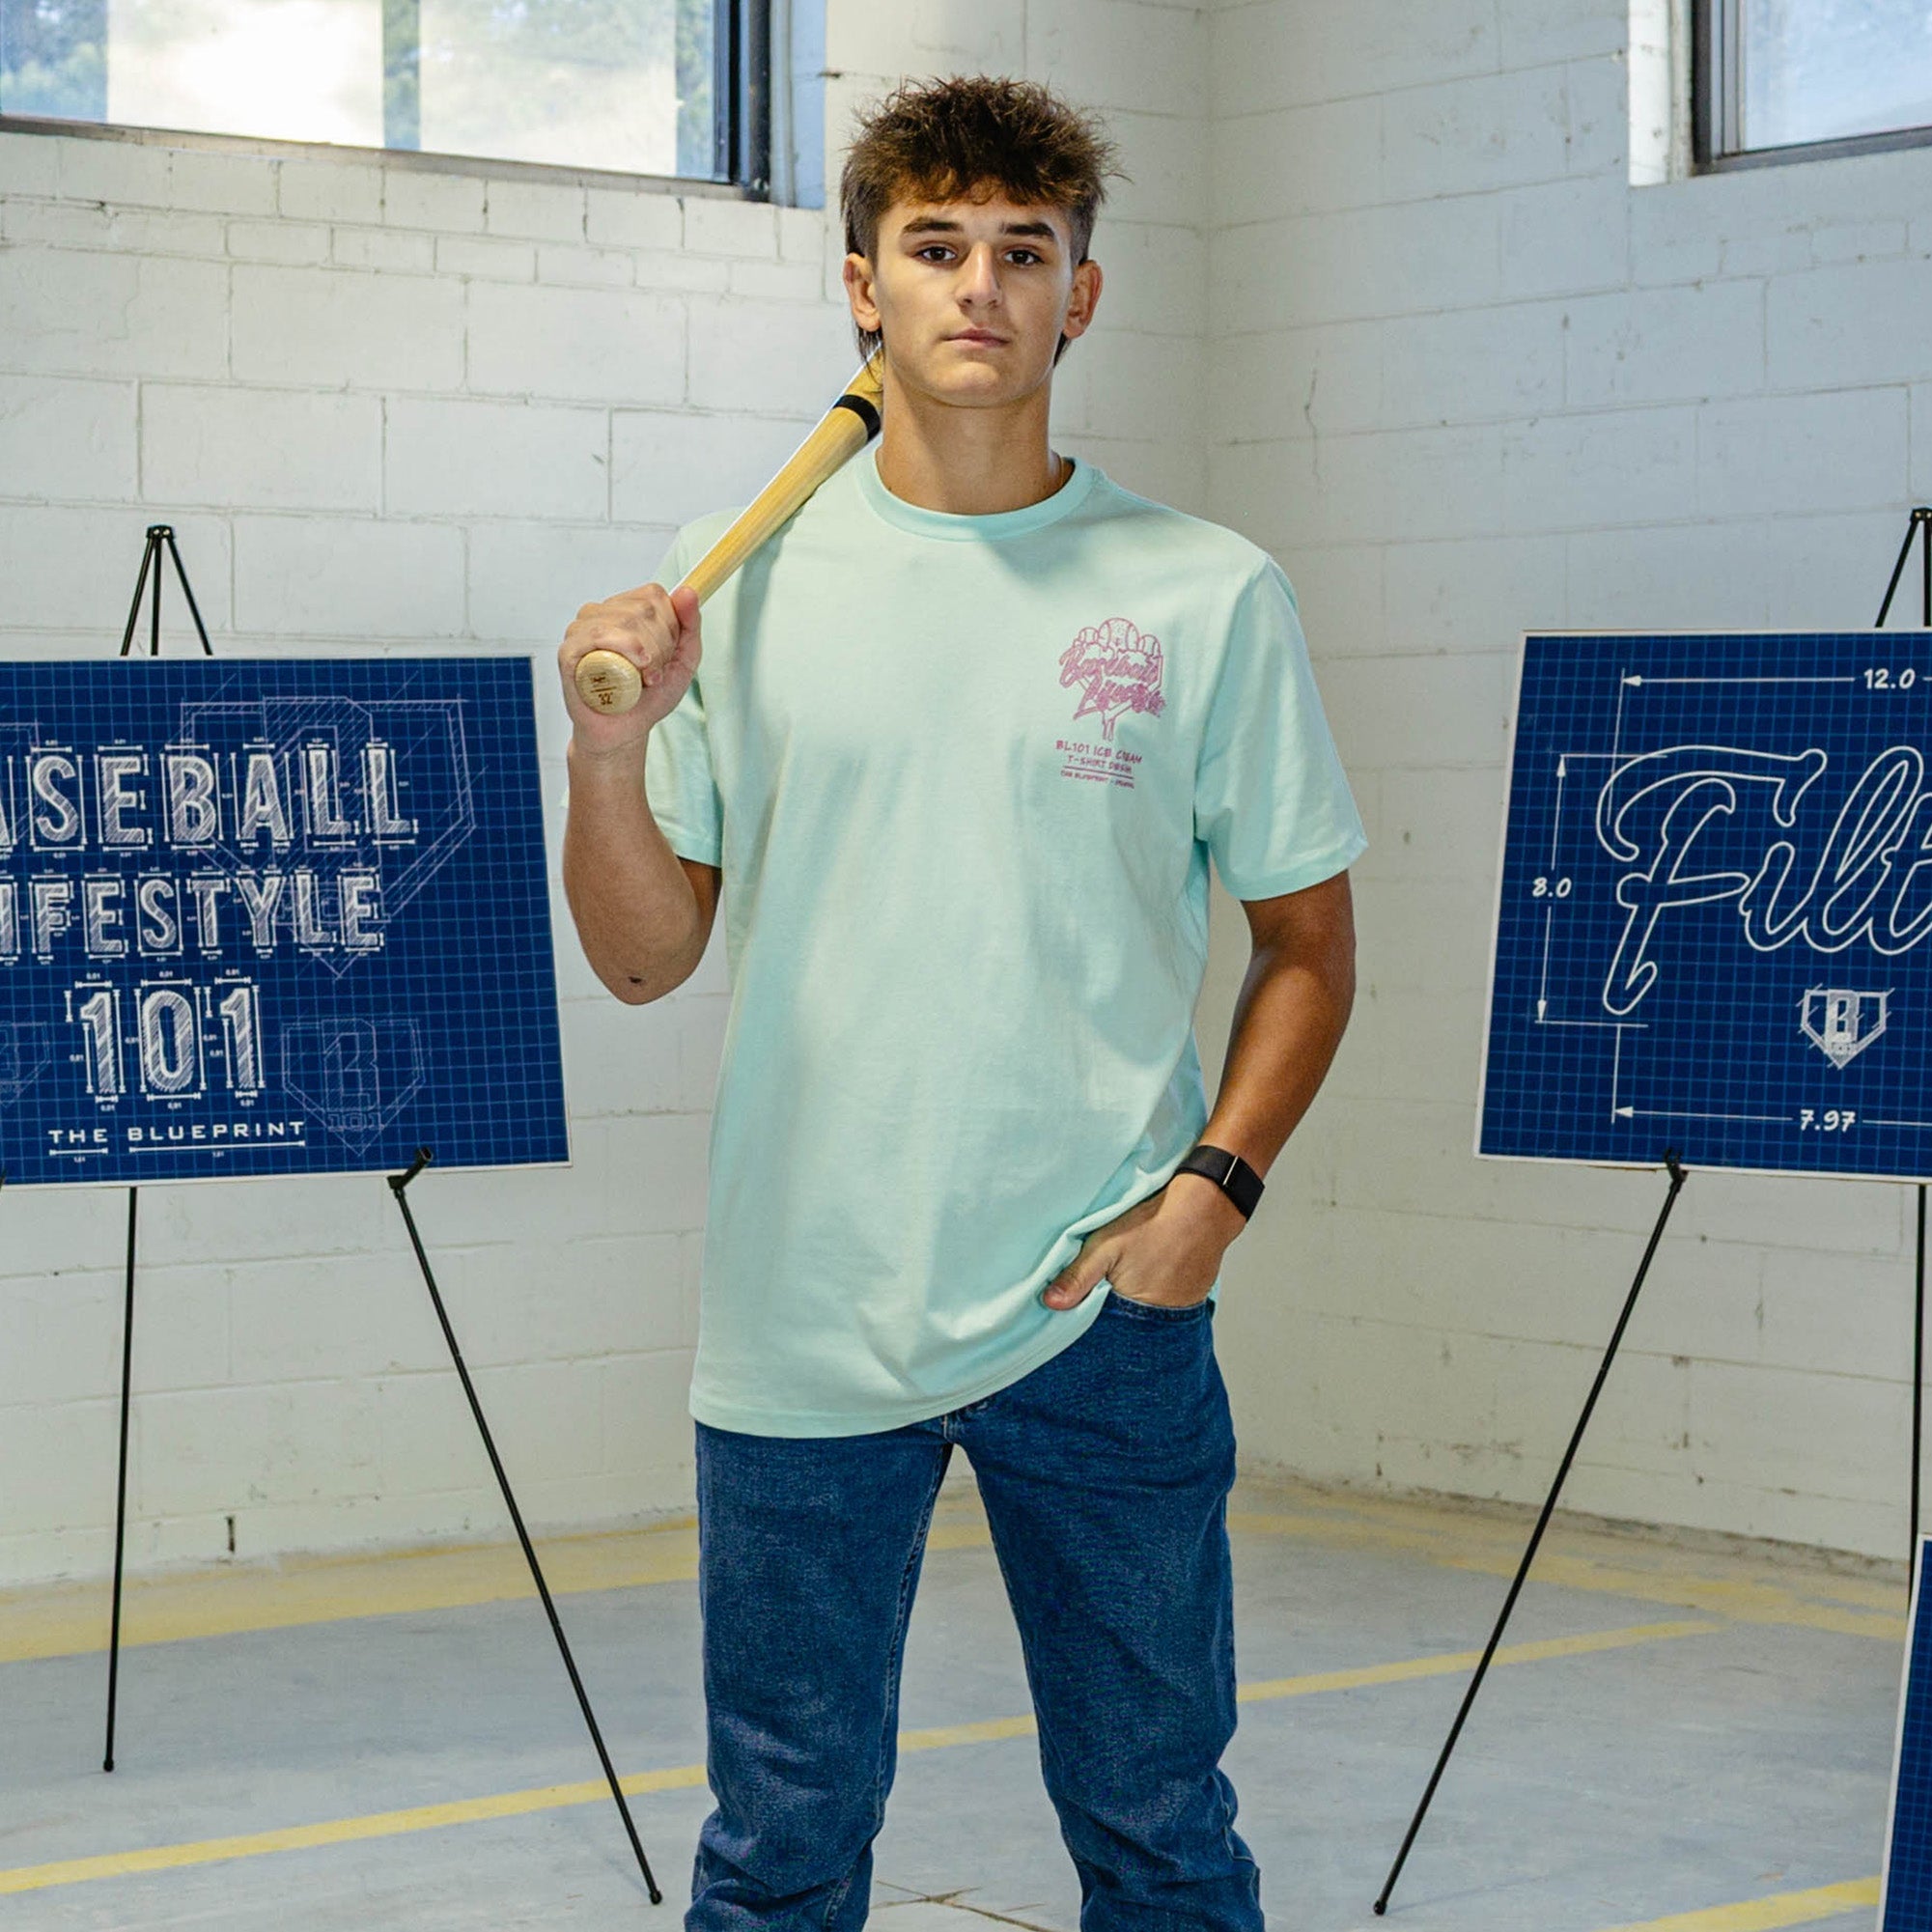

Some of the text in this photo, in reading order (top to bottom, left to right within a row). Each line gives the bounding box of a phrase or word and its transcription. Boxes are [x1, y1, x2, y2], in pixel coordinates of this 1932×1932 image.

[1863, 668, 1916, 689] 12.0
[1056, 741, 1089, 753] BL101
[1532, 877, 1572, 898] 8.0
[79, 988, 257, 1094] 101
[1801, 1109, 1856, 1133] 7.97
[48, 1121, 305, 1144] THE BLUEPRINT
